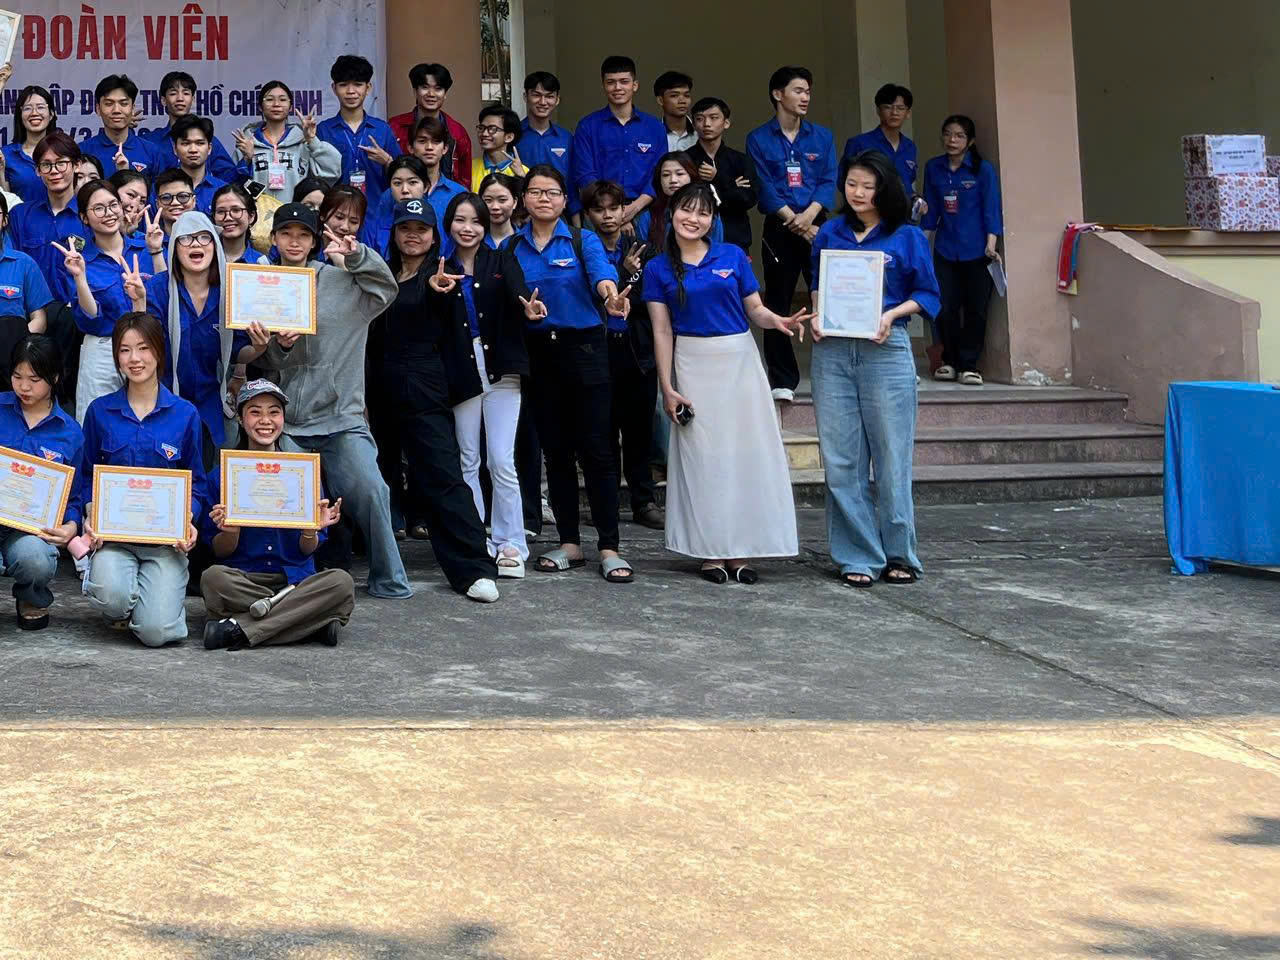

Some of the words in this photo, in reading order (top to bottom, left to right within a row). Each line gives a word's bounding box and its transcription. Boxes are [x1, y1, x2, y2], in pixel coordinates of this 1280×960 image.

[22, 3, 127, 59] ĐOÀN
[143, 3, 229, 60] VIÊN
[196, 84, 224, 116] HỒ
